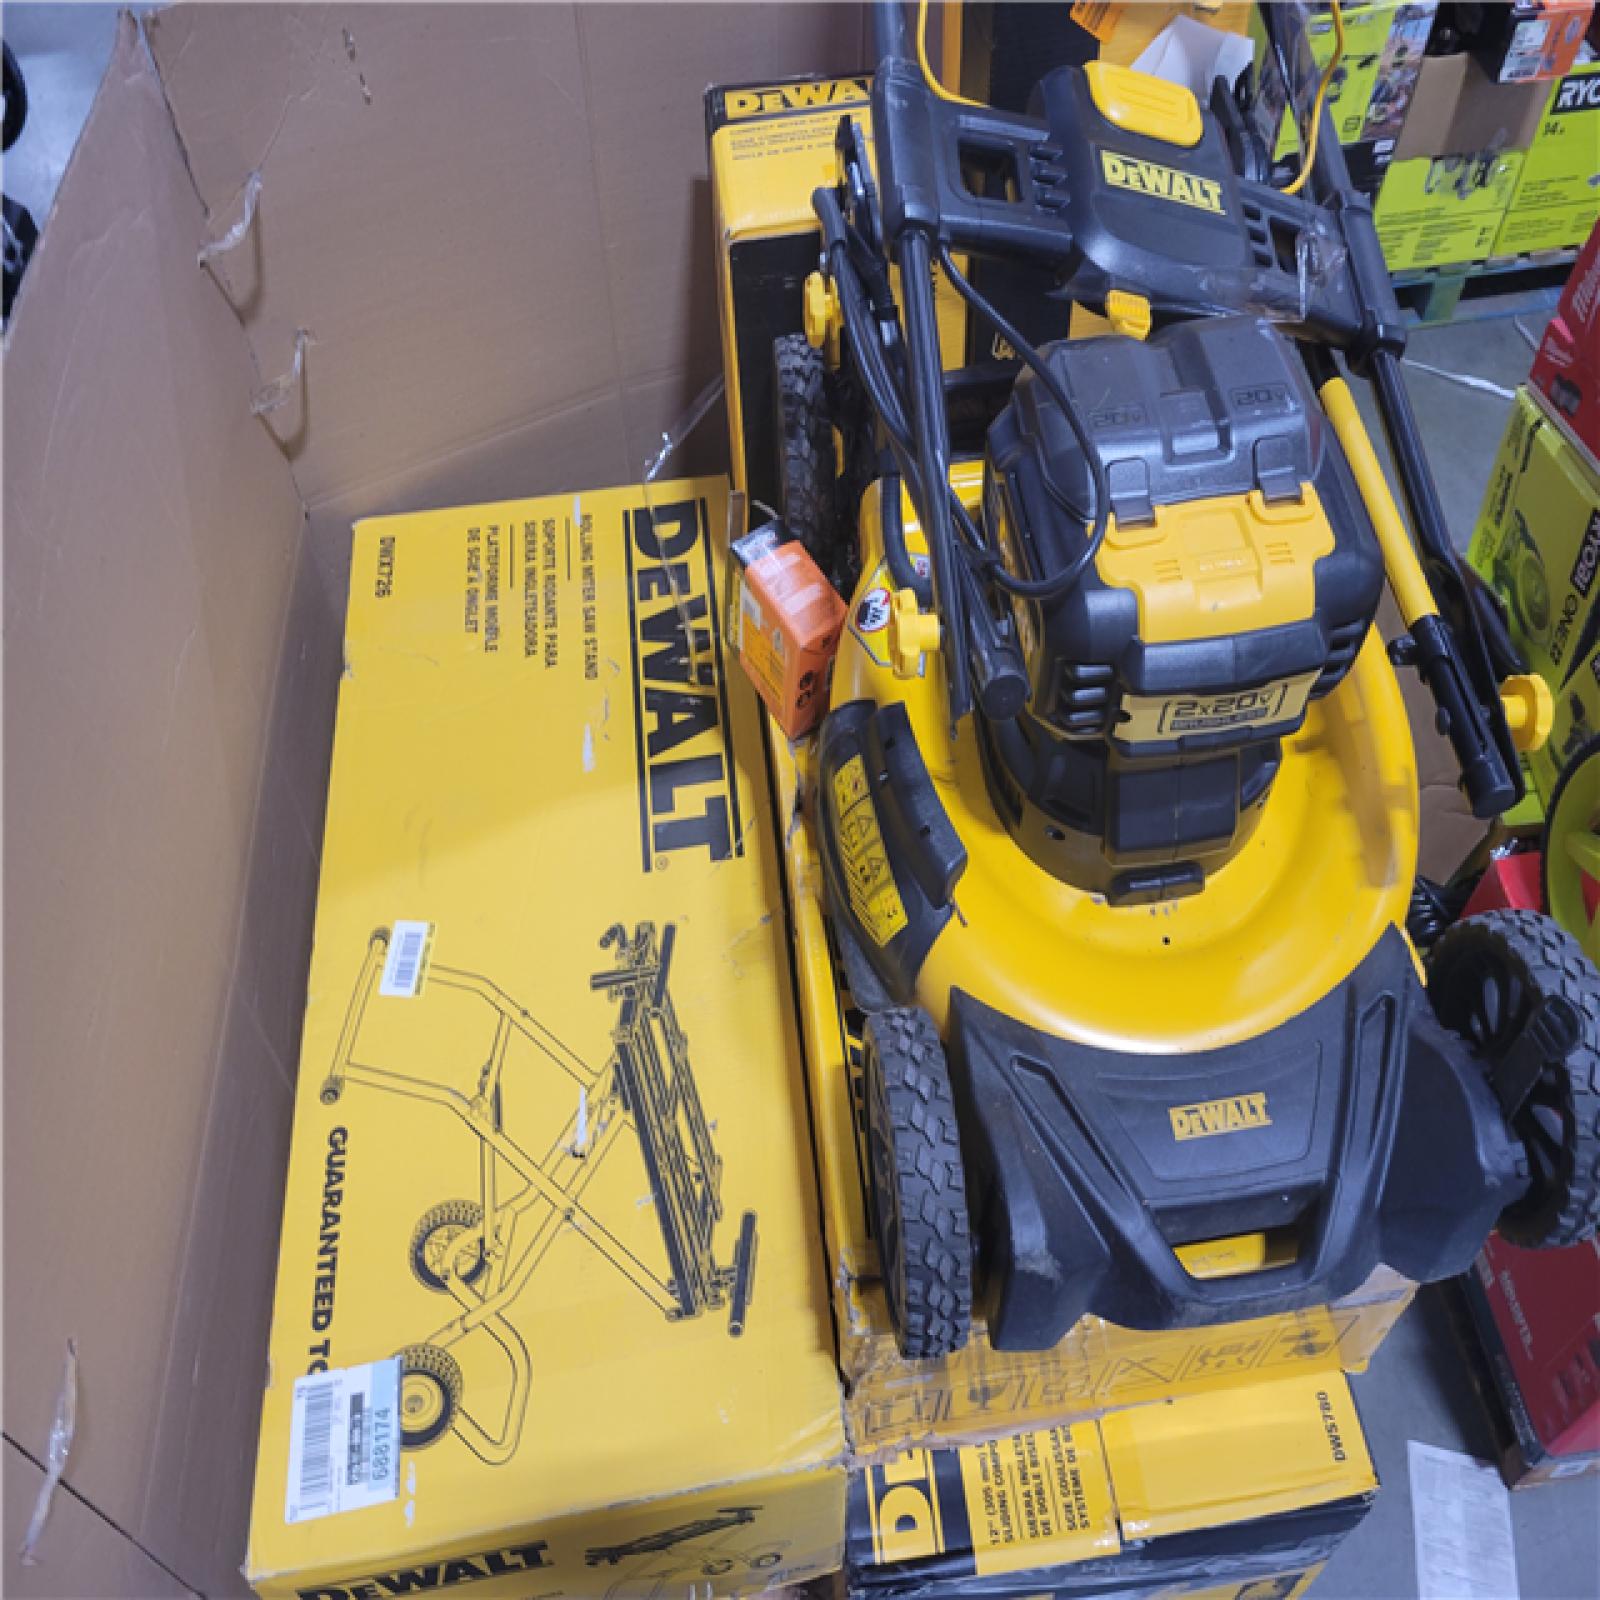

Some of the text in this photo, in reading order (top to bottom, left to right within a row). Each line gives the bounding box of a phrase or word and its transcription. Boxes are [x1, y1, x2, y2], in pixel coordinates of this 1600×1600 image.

[1102, 151, 1227, 215] DEWALT
[466, 546, 480, 573] SCIE
[467, 527, 480, 544] DE
[375, 536, 395, 599] DWX726
[484, 525, 499, 602] PLATEFORME
[582, 565, 596, 602] MITER
[465, 588, 479, 634] ONGLET
[523, 520, 538, 657] SIERRA INGLETEADORA
[542, 519, 558, 669] SOPORTE RODANTE PARA
[583, 606, 597, 634] SAW
[584, 637, 598, 681] STAND
[632, 499, 732, 862] DEWALT
[1168, 1091, 1273, 1141] DEWALT
[311, 1126, 348, 1331] GUARANTEED
[372, 1407, 391, 1481] 688174
[1065, 1448, 1076, 1463] DE
[997, 1490, 1013, 1543] SLIDING
[1023, 1490, 1039, 1538] SIERRA
[1032, 1473, 1047, 1515] DOBLE
[1063, 1502, 1077, 1531] SCIE
[1040, 1519, 1052, 1536] DE
[298, 1541, 549, 1600] DEWALT
